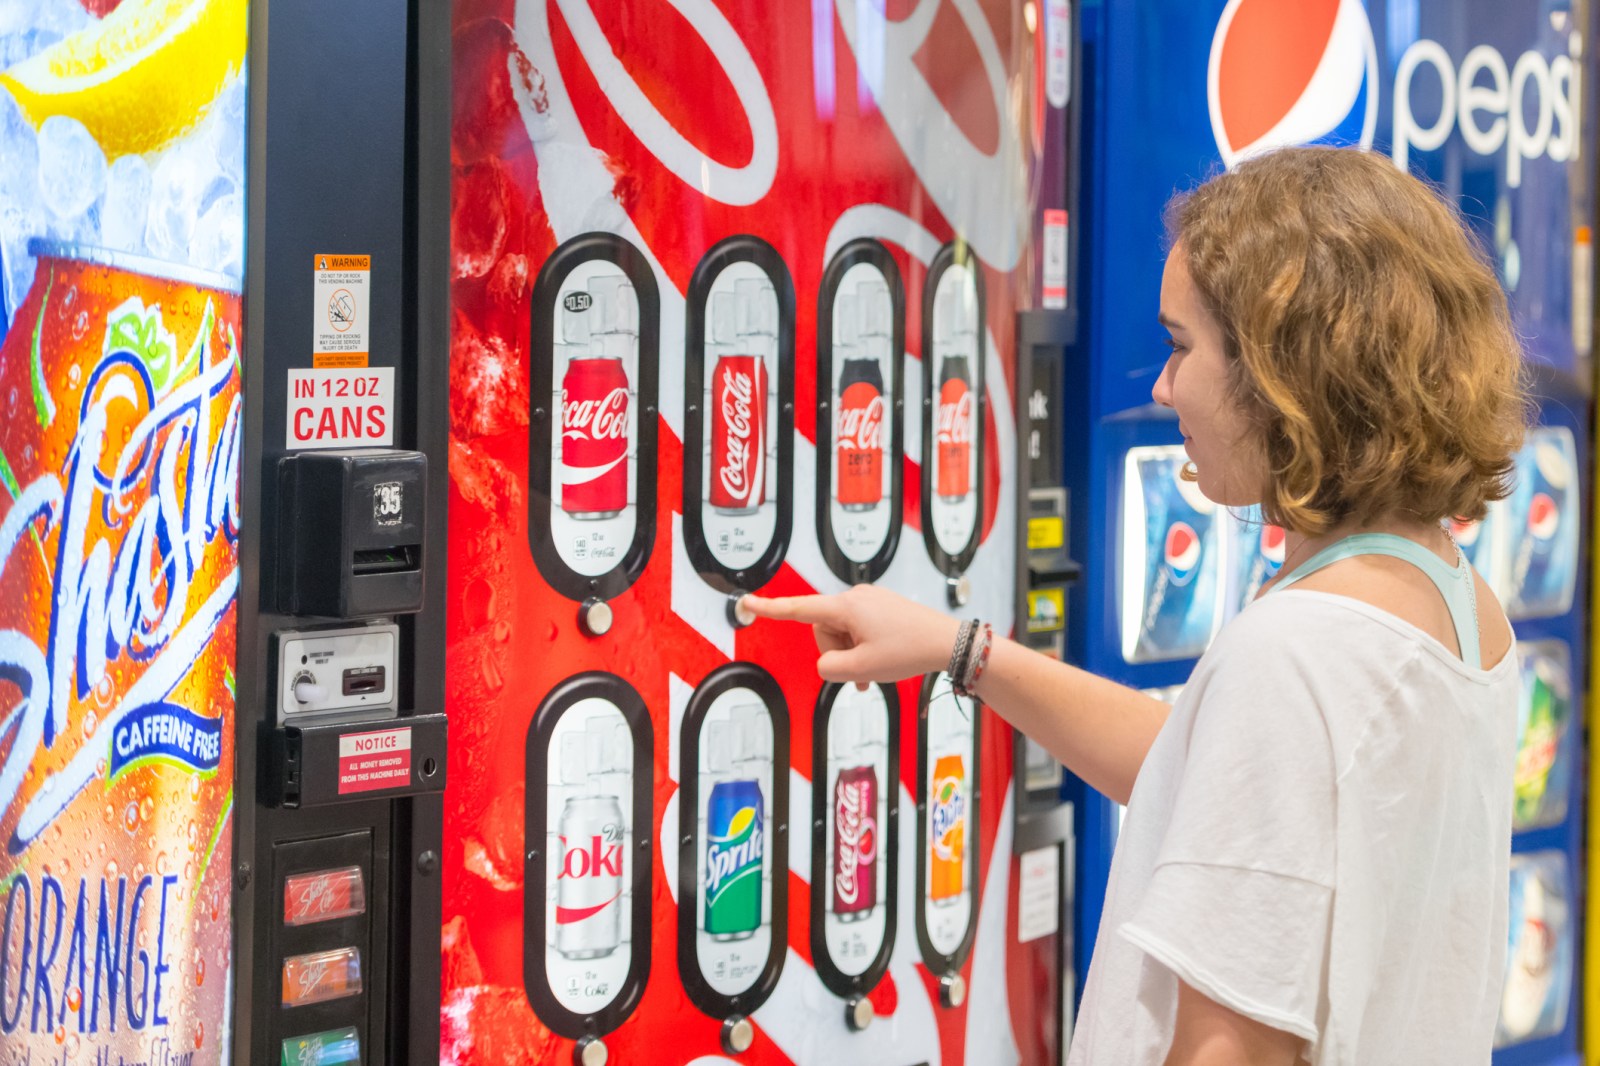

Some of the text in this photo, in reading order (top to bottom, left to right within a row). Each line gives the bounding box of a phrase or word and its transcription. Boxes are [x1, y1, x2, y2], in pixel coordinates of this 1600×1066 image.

[1392, 33, 1582, 188] pepsi
[331, 257, 368, 268] WARNING
[565, 295, 590, 311] $0.50
[294, 377, 379, 399] IN 12 OZ
[293, 405, 386, 441] CANS
[562, 387, 629, 441] oca-Col
[720, 366, 752, 500] Coca-Cola
[116, 714, 220, 761] CAFFEINE FREE
[355, 735, 397, 752] NOTICE
[341, 767, 410, 784] FROM THIS MACHINE DAILY
[349, 757, 402, 771] ALL MONEY REMOVED
[2, 873, 178, 1034] ORANGE
